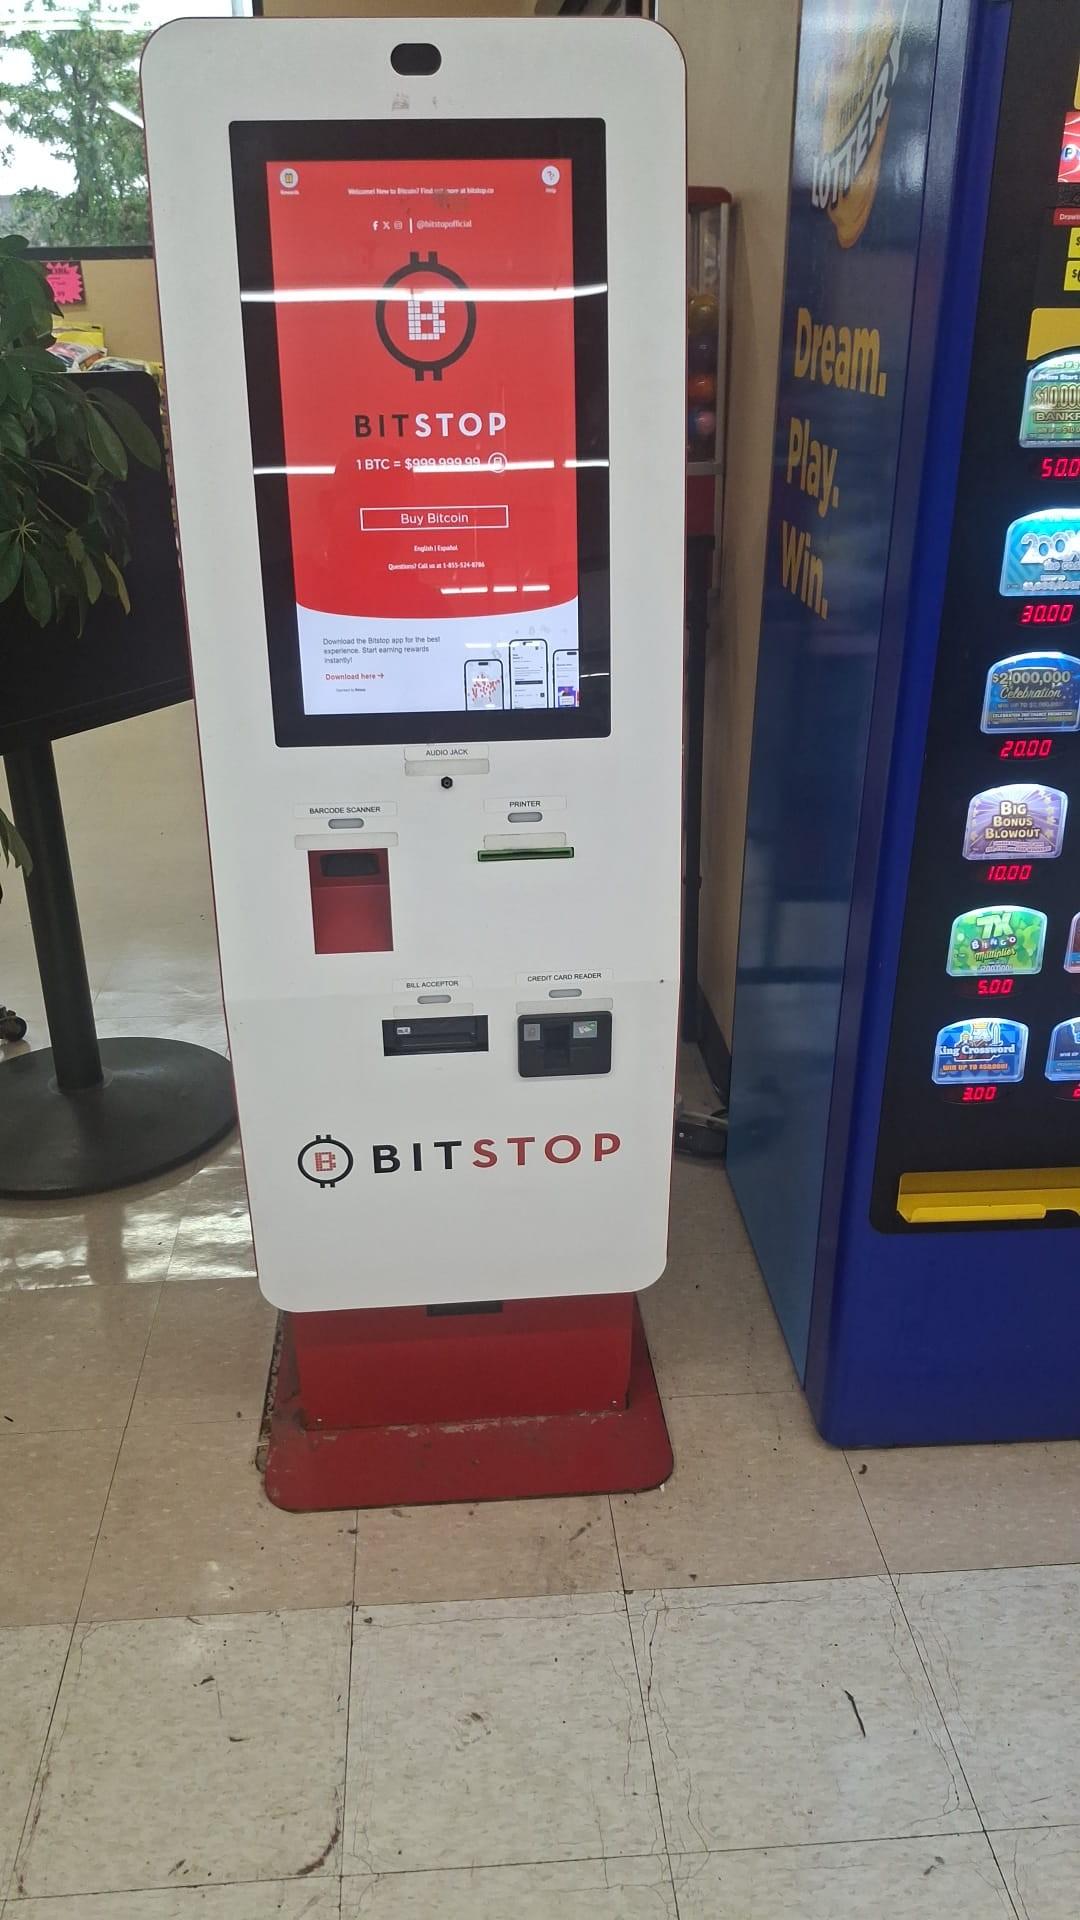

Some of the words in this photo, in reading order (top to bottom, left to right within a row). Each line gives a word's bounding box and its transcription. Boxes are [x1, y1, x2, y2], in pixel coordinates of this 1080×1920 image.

[811, 0, 910, 209] LOTTERY
[417, 220, 472, 230] @bitstopofficial
[794, 307, 888, 397] Dream.
[354, 412, 506, 438] BITSTOP
[365, 459, 390, 470] BTC
[786, 417, 840, 518] Play.
[400, 513, 424, 526] Buy
[428, 512, 468, 524] Bitcoin
[438, 544, 458, 552] Español
[388, 563, 416, 571] Questions?
[781, 520, 828, 620] Win.
[1021, 604, 1074, 623] 30.00
[362, 646, 377, 654] Start
[379, 646, 402, 654] earning
[1000, 686, 1062, 699] Celebration
[450, 748, 468, 756] JACK
[510, 800, 540, 808] PRINTER
[310, 807, 344, 815] BARCODE
[346, 806, 380, 814] SCANNER
[988, 865, 1032, 880] 10.00
[574, 972, 602, 980] READER
[422, 980, 458, 988] ACCEPTOR
[962, 1044, 1016, 1055] Crossword
[372, 1133, 620, 1174] BITSTOP
